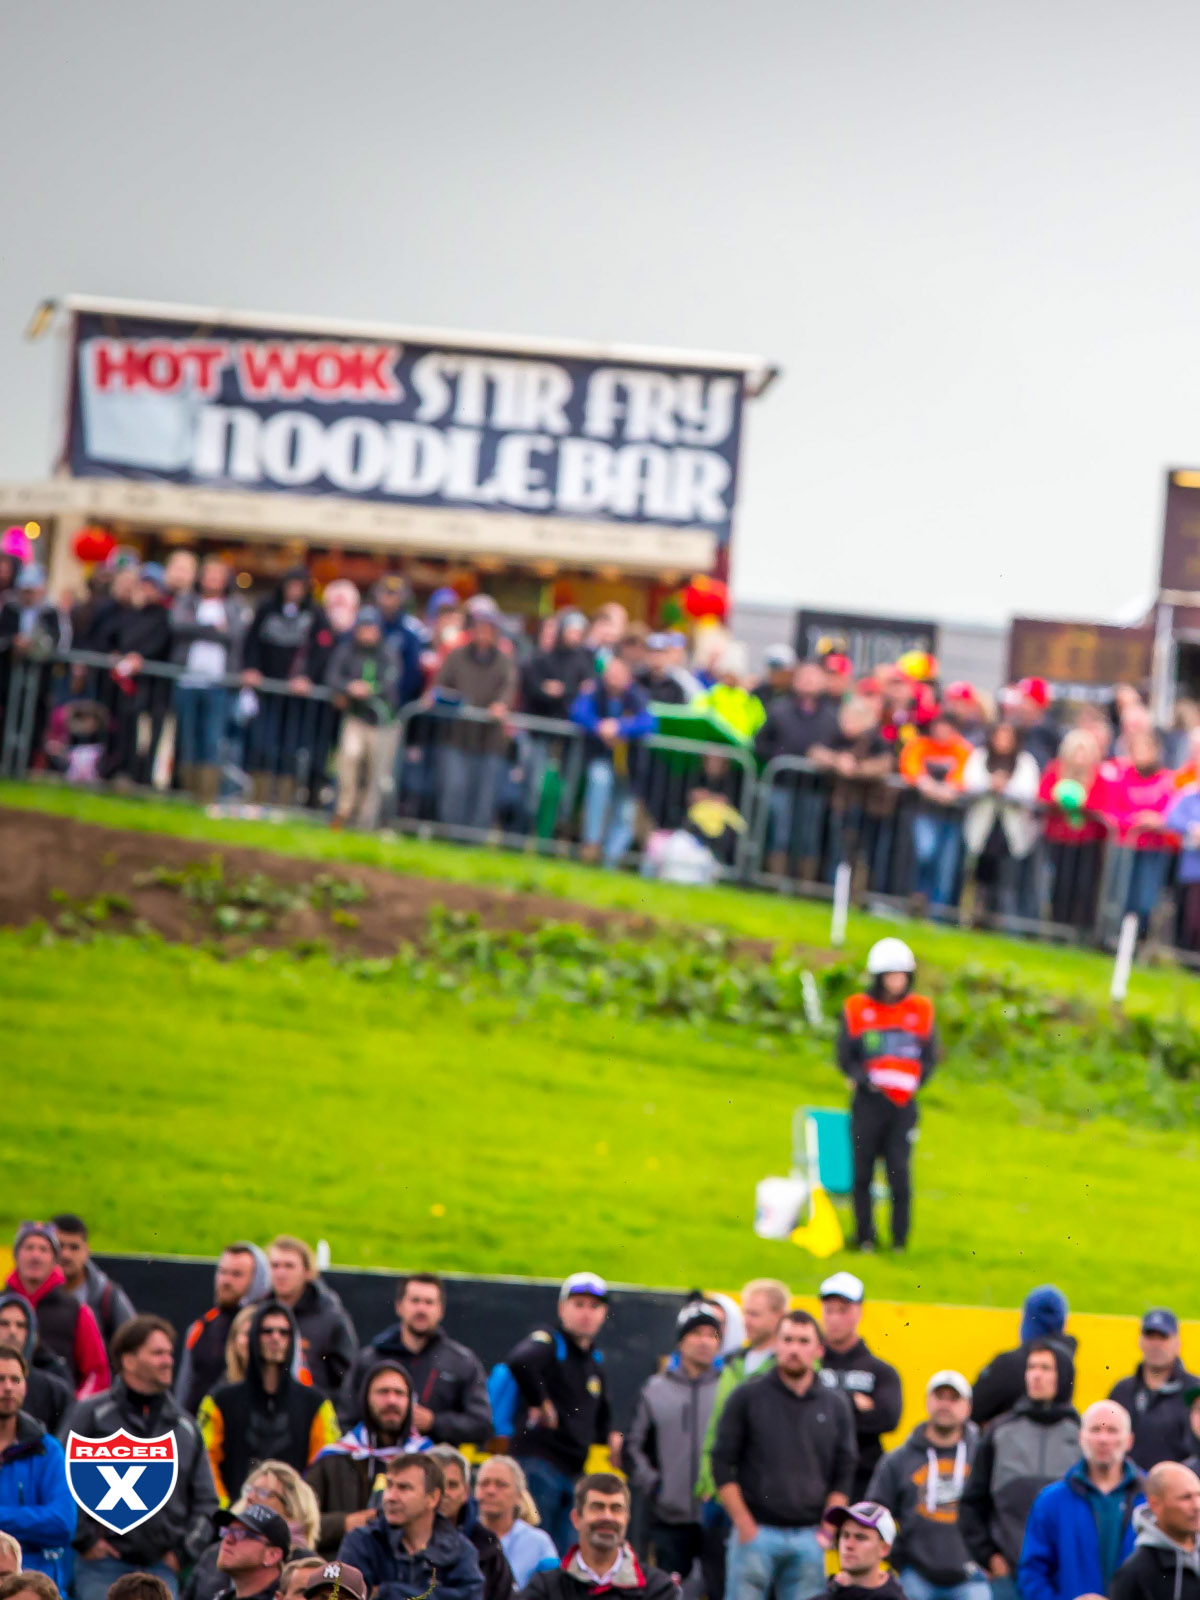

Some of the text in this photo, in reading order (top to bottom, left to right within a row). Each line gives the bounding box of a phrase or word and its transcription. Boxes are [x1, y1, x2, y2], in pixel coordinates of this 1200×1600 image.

[94, 340, 738, 446] HOT WOK STIR FRY
[198, 404, 732, 520] NOODLE BAR
